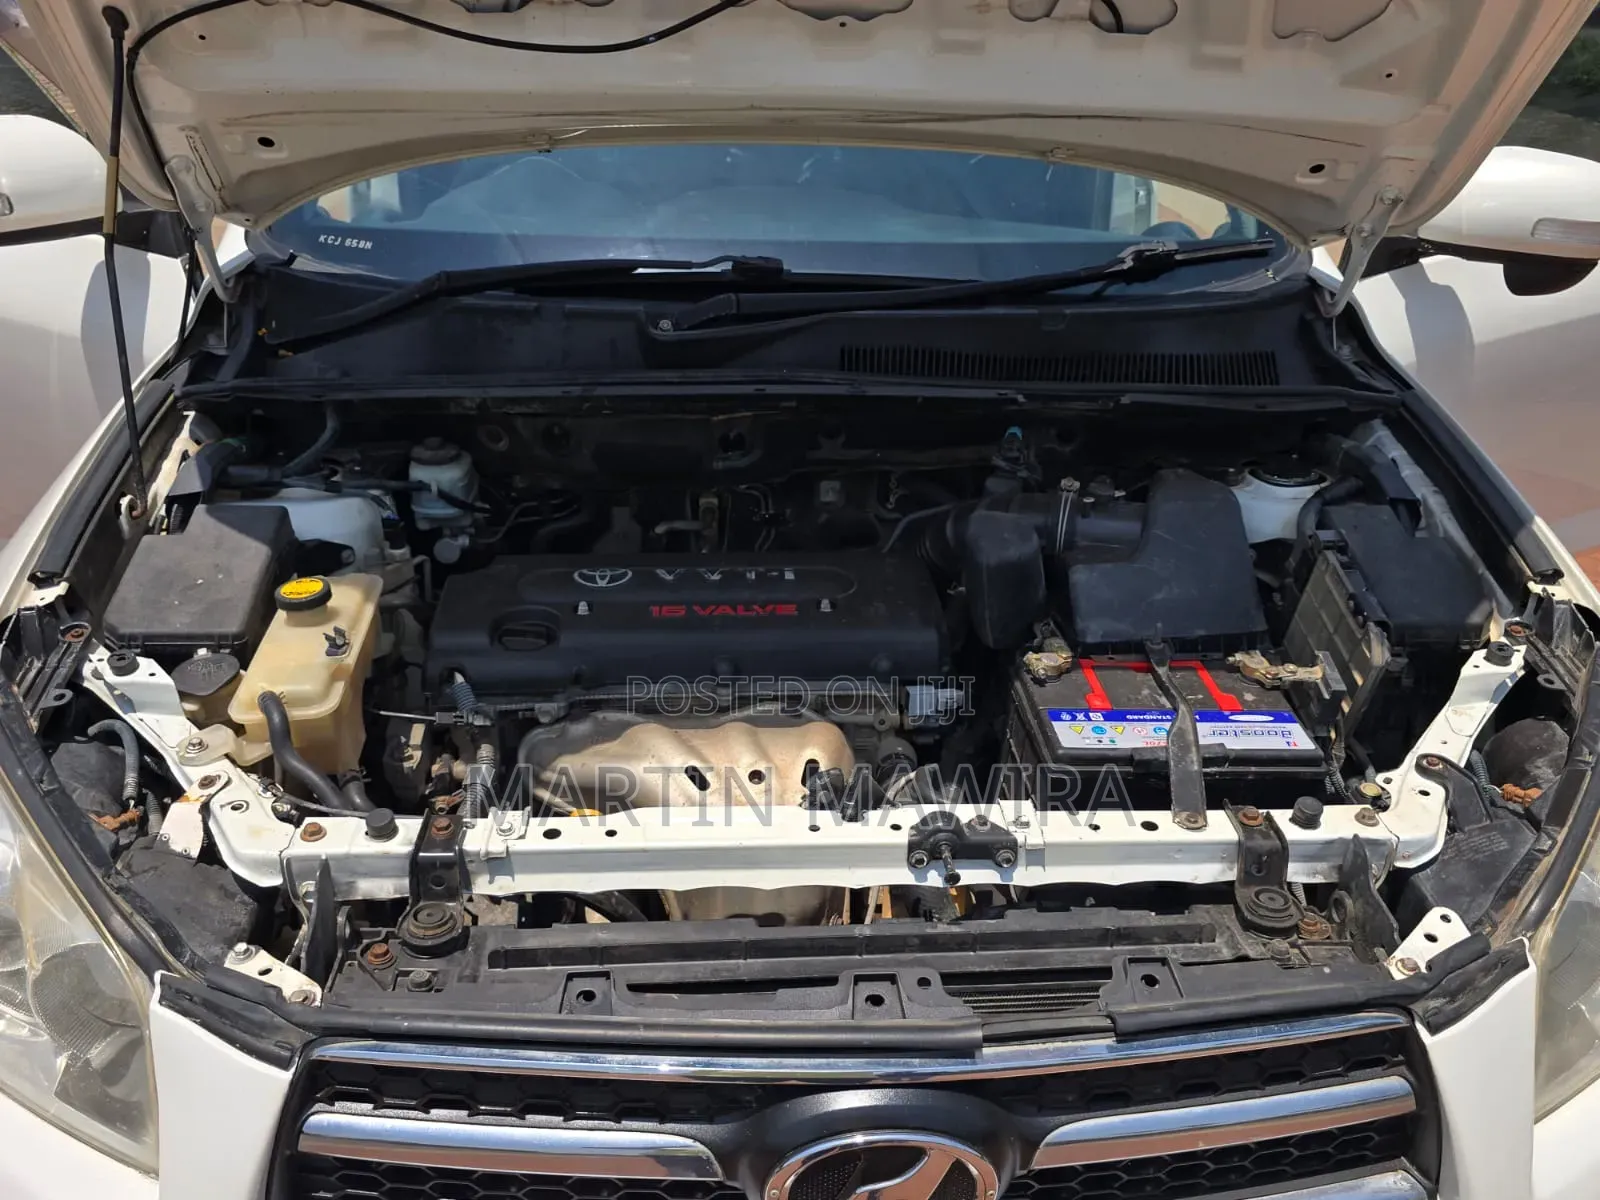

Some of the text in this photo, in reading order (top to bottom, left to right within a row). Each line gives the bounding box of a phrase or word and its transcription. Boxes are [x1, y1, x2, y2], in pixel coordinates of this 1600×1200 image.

[318, 234, 342, 246] KCJ
[649, 604, 799, 617] 16 VALVE
[1208, 729, 1293, 739] Booster
